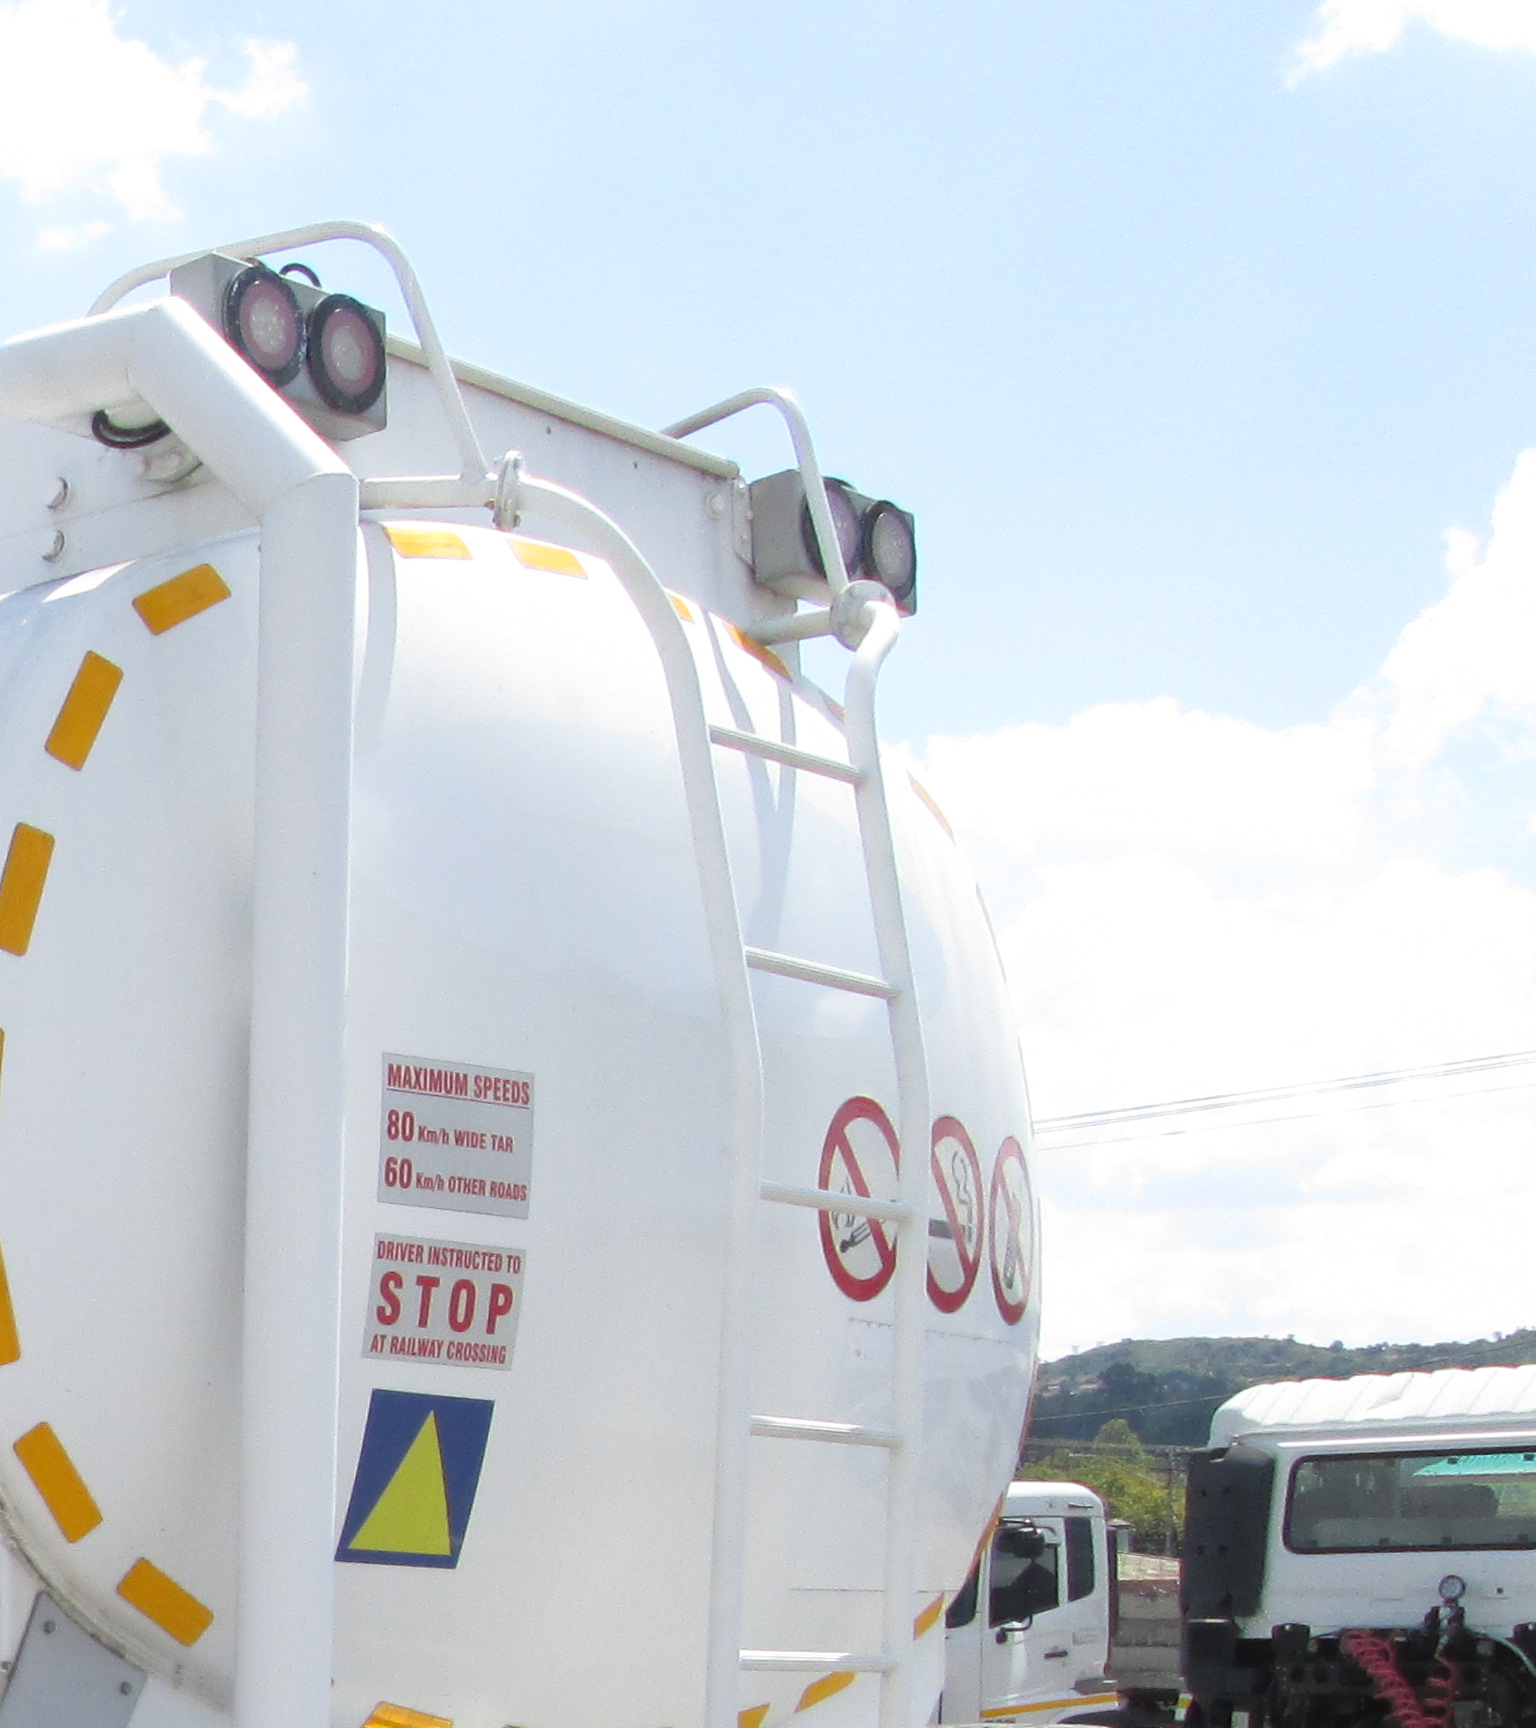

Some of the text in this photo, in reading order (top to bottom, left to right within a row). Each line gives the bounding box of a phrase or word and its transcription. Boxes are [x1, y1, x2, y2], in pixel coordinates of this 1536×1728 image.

[387, 1063, 530, 1105] MAXIMUM SPEEDS
[386, 1109, 513, 1153] 80 Km/h WIDE TAR
[384, 1157, 527, 1201] 60 Km/h OTHER ROADS
[376, 1240, 521, 1274] DRIVER INSTRUCTED TO
[376, 1271, 514, 1335] STOP
[370, 1334, 507, 1364] AT RAILWAY CROSSING
